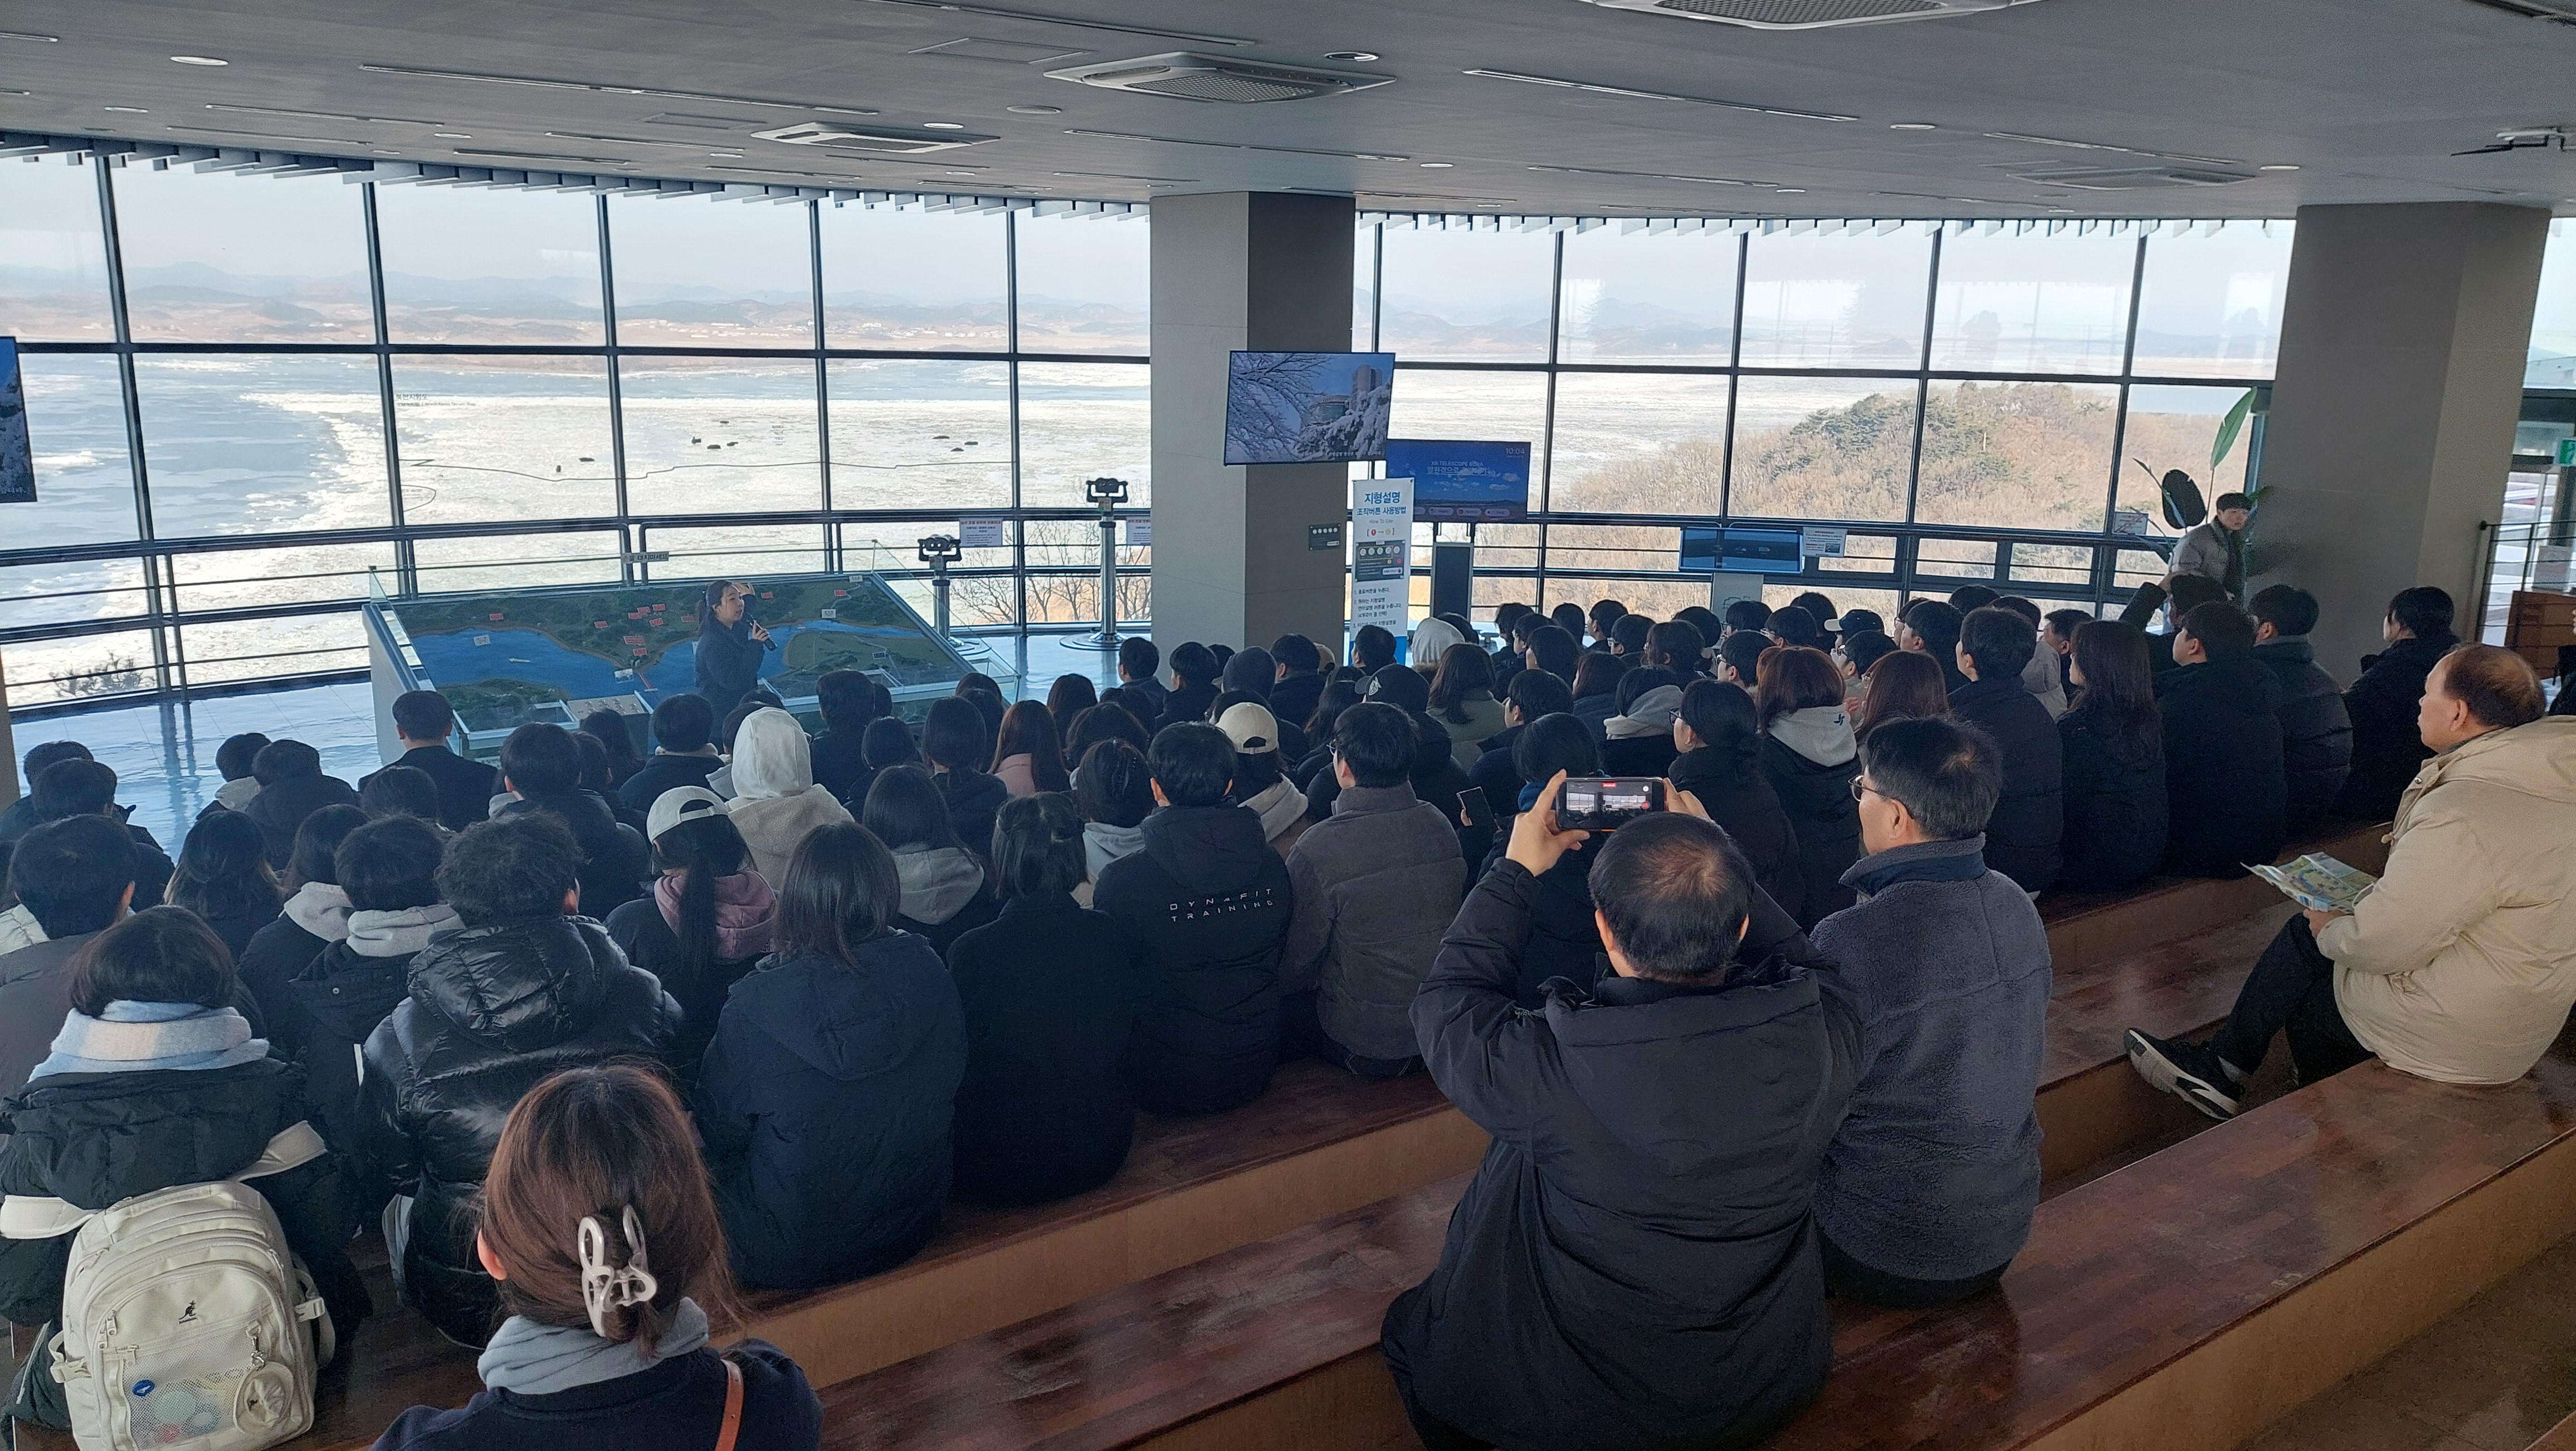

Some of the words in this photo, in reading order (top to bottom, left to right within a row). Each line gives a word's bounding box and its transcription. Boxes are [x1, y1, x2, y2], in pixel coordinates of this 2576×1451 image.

[1364, 491, 1401, 504] 지형설명
[1357, 507, 1380, 515] 조작버튼
[1383, 506, 1407, 514] 사용방법
[1169, 888, 1272, 910] DYNAFIT
[1171, 899, 1274, 922] TRAINING
